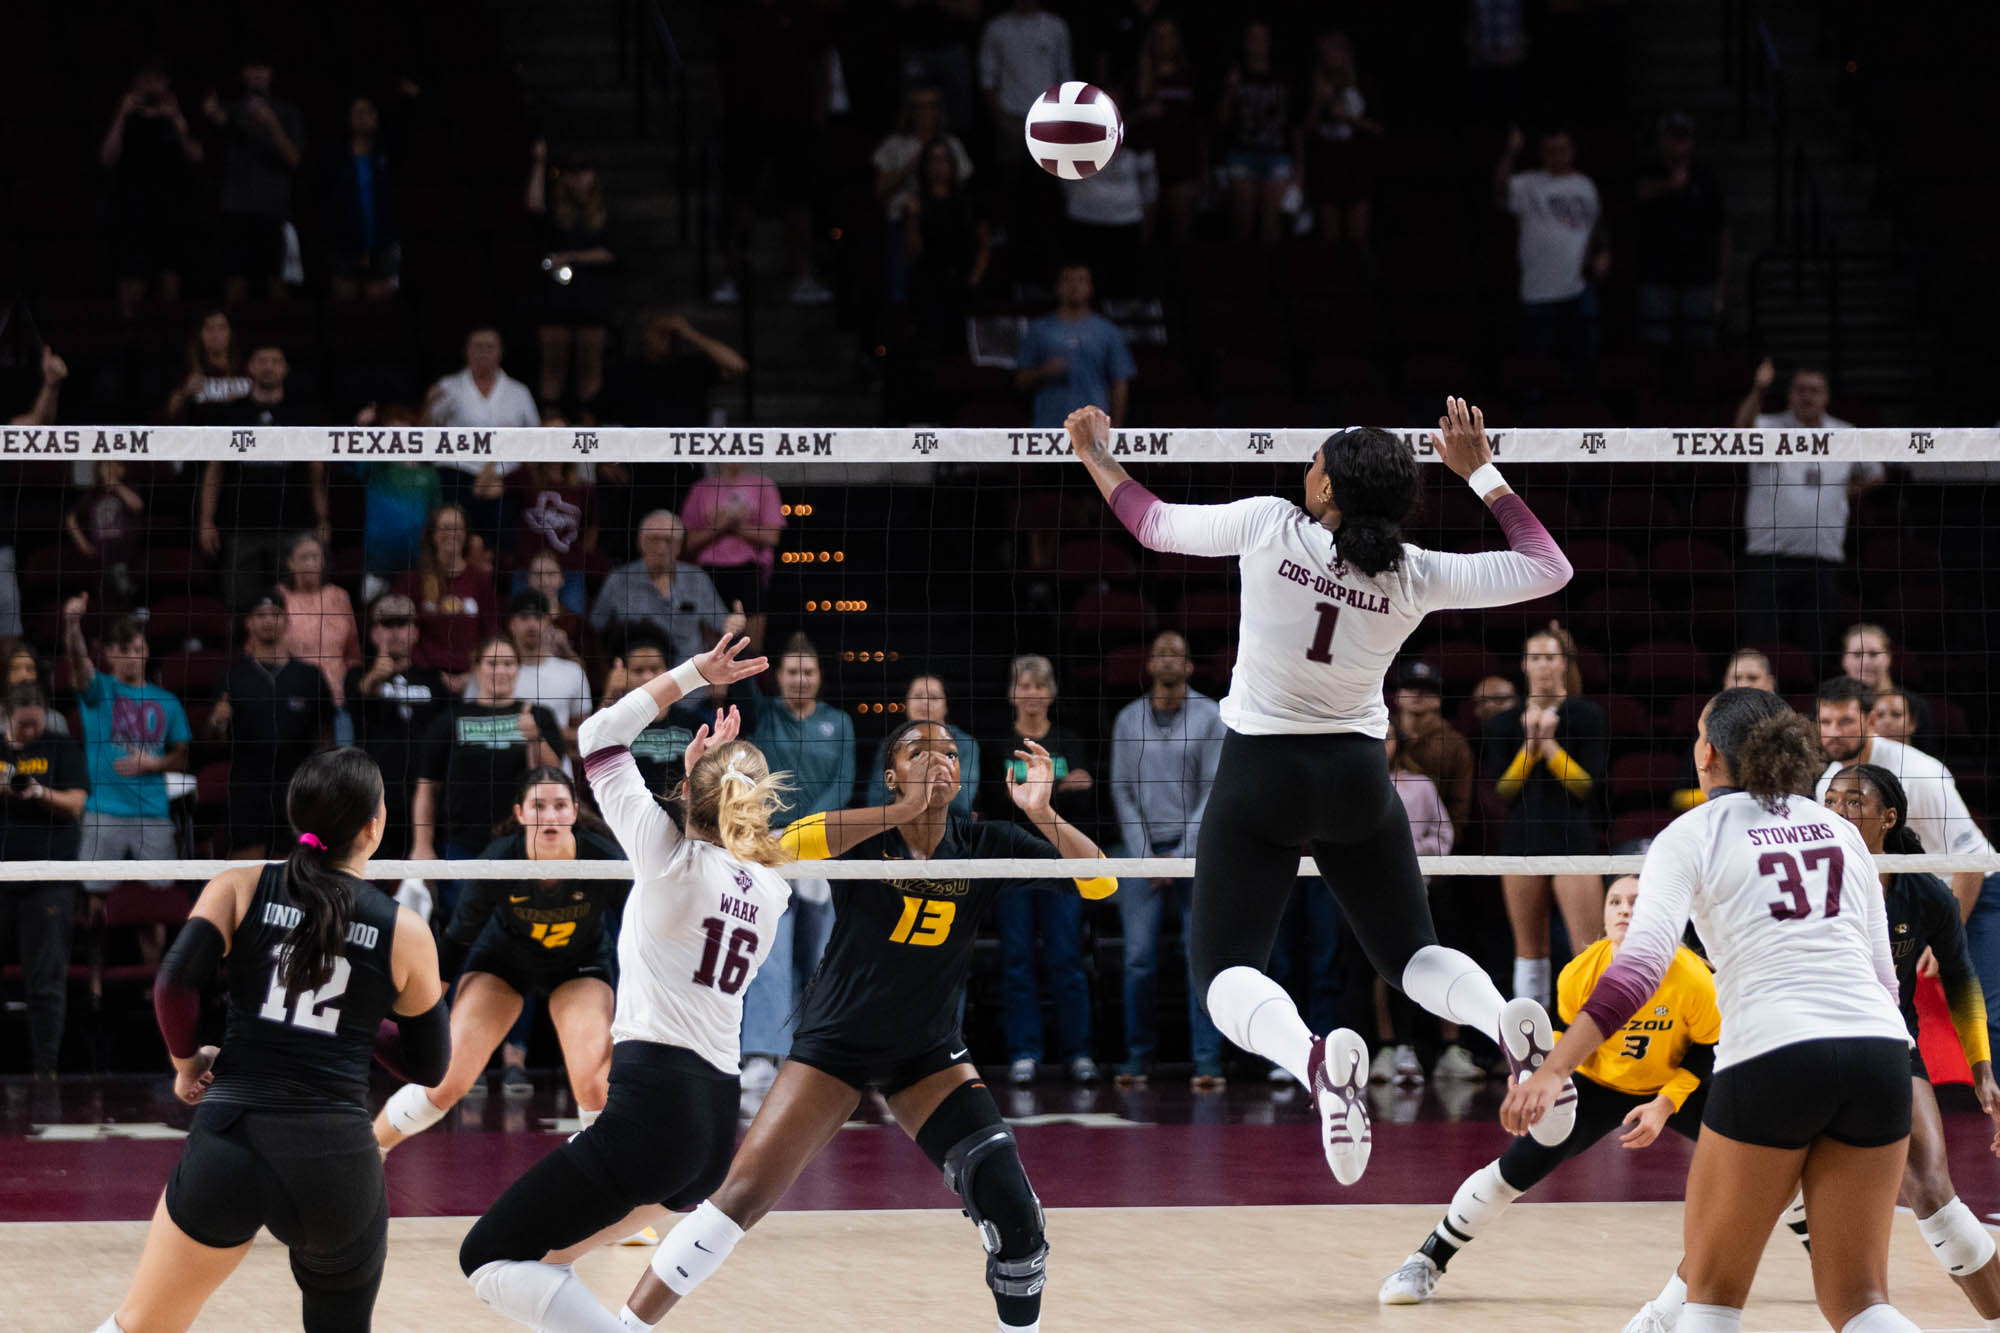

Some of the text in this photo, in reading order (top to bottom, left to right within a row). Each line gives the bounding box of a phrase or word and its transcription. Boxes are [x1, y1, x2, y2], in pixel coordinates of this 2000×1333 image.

[0, 431, 149, 454] EXAS A&M
[329, 431, 492, 455] TEXAS A&M
[670, 433, 832, 456] TEXAS A&M
[1112, 433, 1169, 456] A&M
[1672, 433, 1830, 456] TEXAS A&M
[1278, 558, 1391, 615] COS-OKPALLA
[1305, 601, 1341, 666] 1
[1747, 823, 1835, 846] STOWERS
[1758, 846, 1845, 921] 37
[720, 892, 759, 925] WAAK
[888, 896, 957, 947] 13
[263, 902, 380, 950] UNDOOD
[530, 921, 577, 949] 12
[692, 916, 759, 996] 16
[259, 942, 352, 1036] 12
[1622, 1019, 1674, 1031] ZOU
[1620, 1034, 1651, 1060] 3
